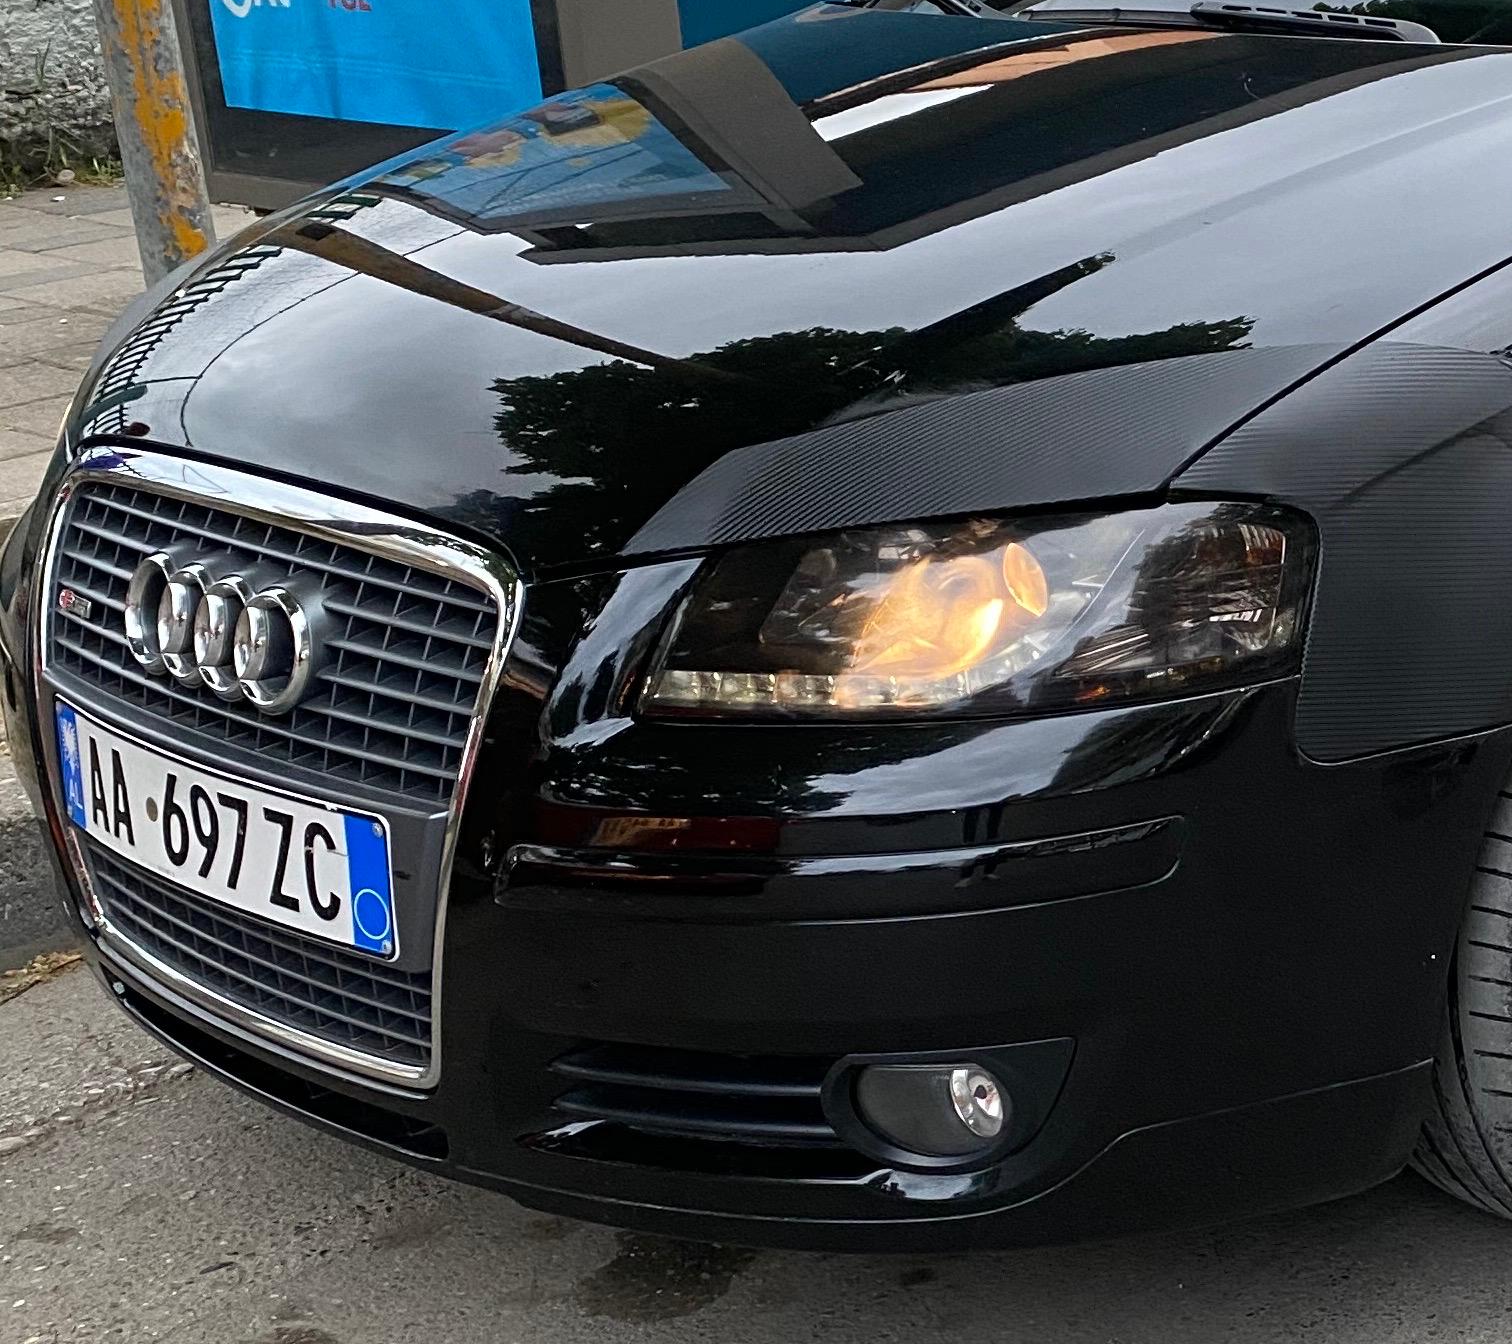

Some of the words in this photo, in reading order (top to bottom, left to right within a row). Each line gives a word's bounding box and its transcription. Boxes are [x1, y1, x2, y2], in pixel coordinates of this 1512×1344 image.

[88, 735, 135, 847] AA
[161, 773, 250, 890] 697
[263, 809, 341, 922] ZC
